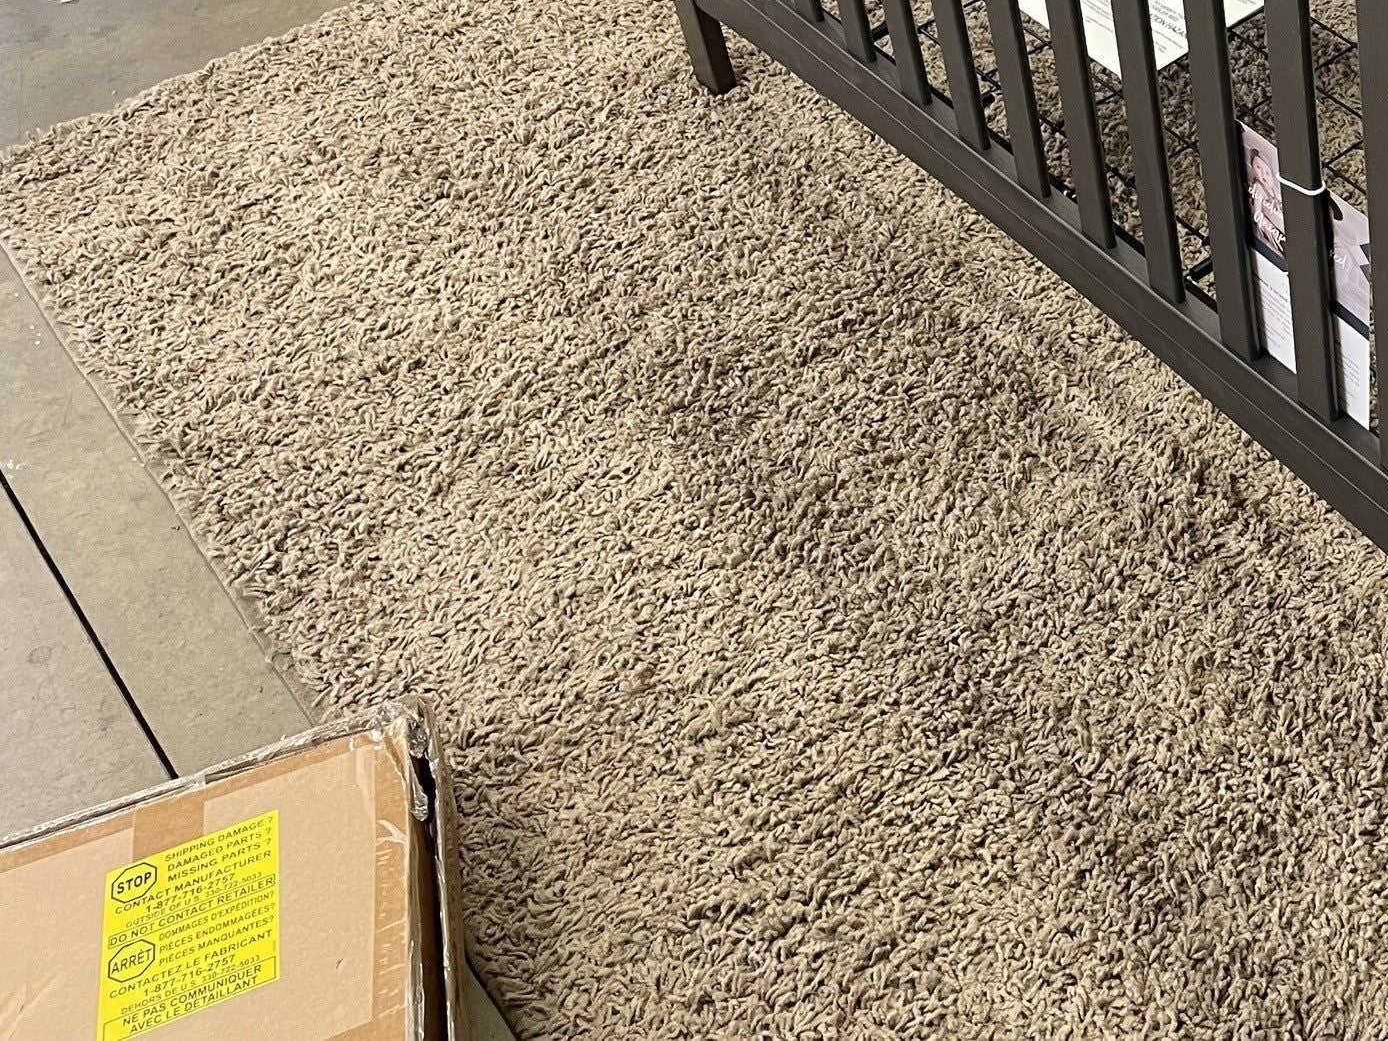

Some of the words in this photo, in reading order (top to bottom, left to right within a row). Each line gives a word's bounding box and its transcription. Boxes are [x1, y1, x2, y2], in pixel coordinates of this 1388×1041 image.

[165, 838, 214, 861] SHIPPING
[218, 820, 264, 843] DAMAGE
[167, 846, 223, 871] DAMAGED
[227, 832, 262, 848] PARTS
[115, 889, 170, 914] CONTACT
[174, 850, 271, 891] MANUFACTURER
[117, 872, 151, 894] STOP
[167, 858, 218, 882] MISSING
[222, 843, 261, 861] PARTS
[110, 933, 127, 946] DO
[131, 921, 155, 938] NOT
[158, 899, 214, 927] CONTACT
[217, 877, 274, 904] RETAILER
[126, 909, 166, 928] OUTSIDE
[169, 902, 181, 910] OF
[206, 872, 262, 898] 330-722-5033
[146, 873, 236, 913] 1-877-716-2757
[159, 916, 208, 941] DOMMAGES
[110, 965, 182, 999] CONTACTEZ
[186, 957, 200, 969] LE
[204, 929, 273, 962] FABRICANT
[121, 995, 162, 1015] DEHORS
[164, 988, 177, 998] DE
[202, 954, 261, 983] 330-722-5033
[144, 954, 236, 996] 1-877-716-2757
[123, 1013, 139, 1027] NE
[142, 1002, 166, 1019] PAS
[170, 965, 262, 1007] COMMUNIQUER
[130, 1017, 162, 1034] AVEC
[166, 1008, 181, 1019] LE
